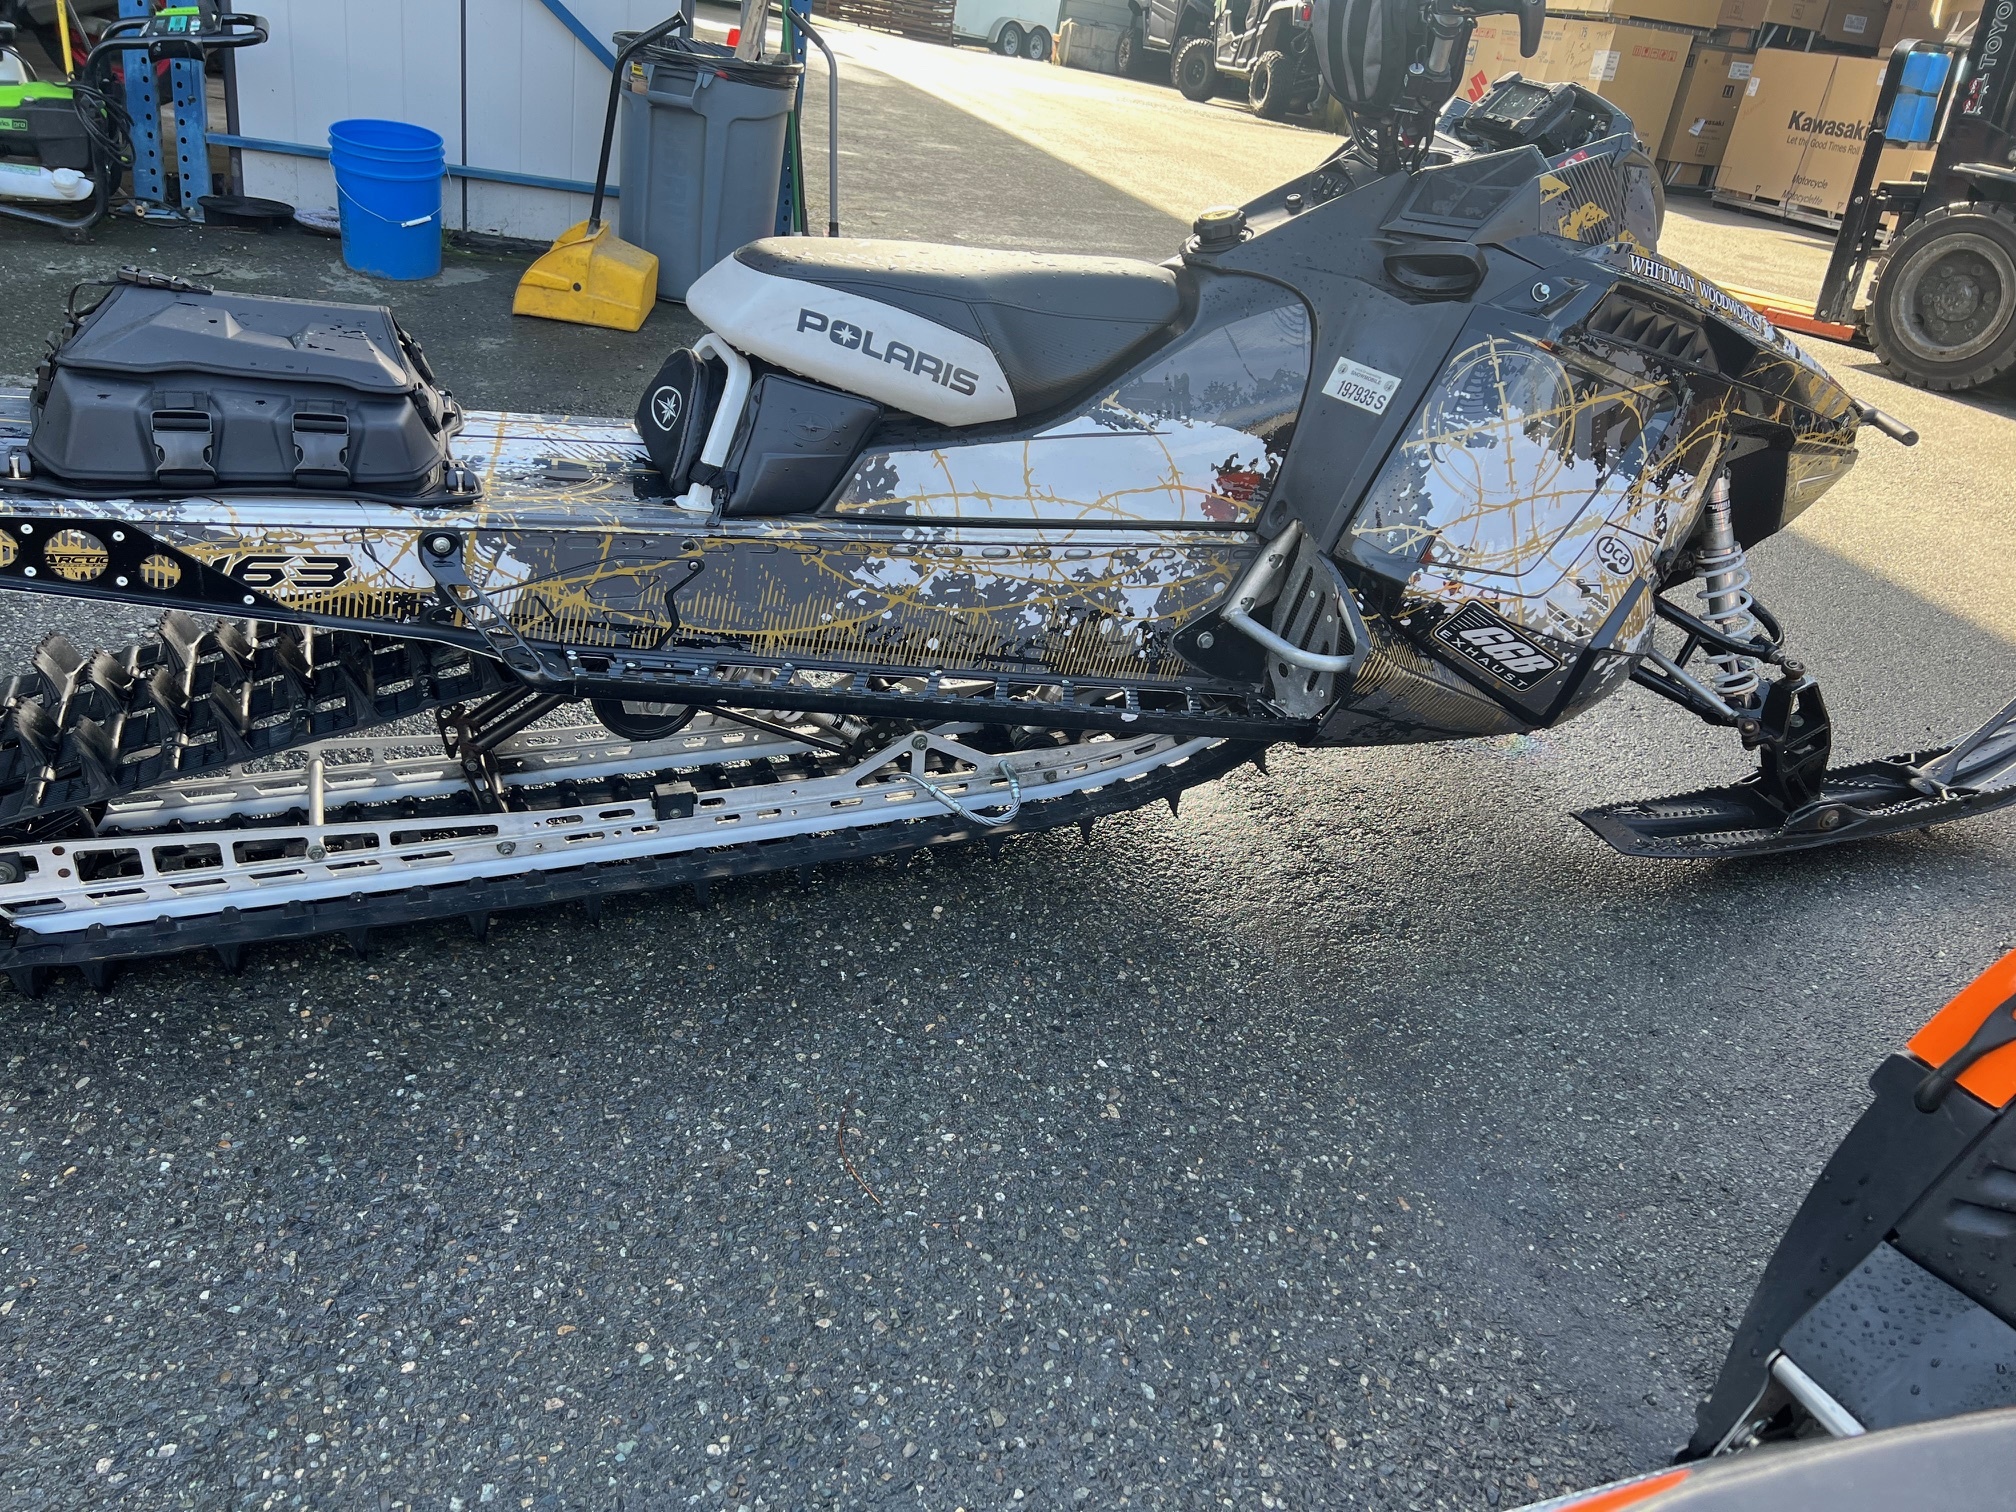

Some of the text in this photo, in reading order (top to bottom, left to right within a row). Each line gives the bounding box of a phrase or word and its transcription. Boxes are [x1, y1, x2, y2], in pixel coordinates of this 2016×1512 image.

[1978, 0, 2013, 69] TOYO
[1788, 110, 1872, 141] Kawasaki
[1787, 135, 1861, 155] Let the Good Times Roll
[1792, 174, 1828, 189] Motorcycle
[1782, 189, 1823, 205] Motocyclette
[1629, 253, 1761, 332] WHITMAN WOODWORKS
[796, 308, 980, 396] POLARIS
[1337, 380, 1377, 406] 197935
[1602, 537, 1630, 567] bca
[1588, 598, 1608, 614] HMK
[1439, 629, 1529, 688] EXHAUST
